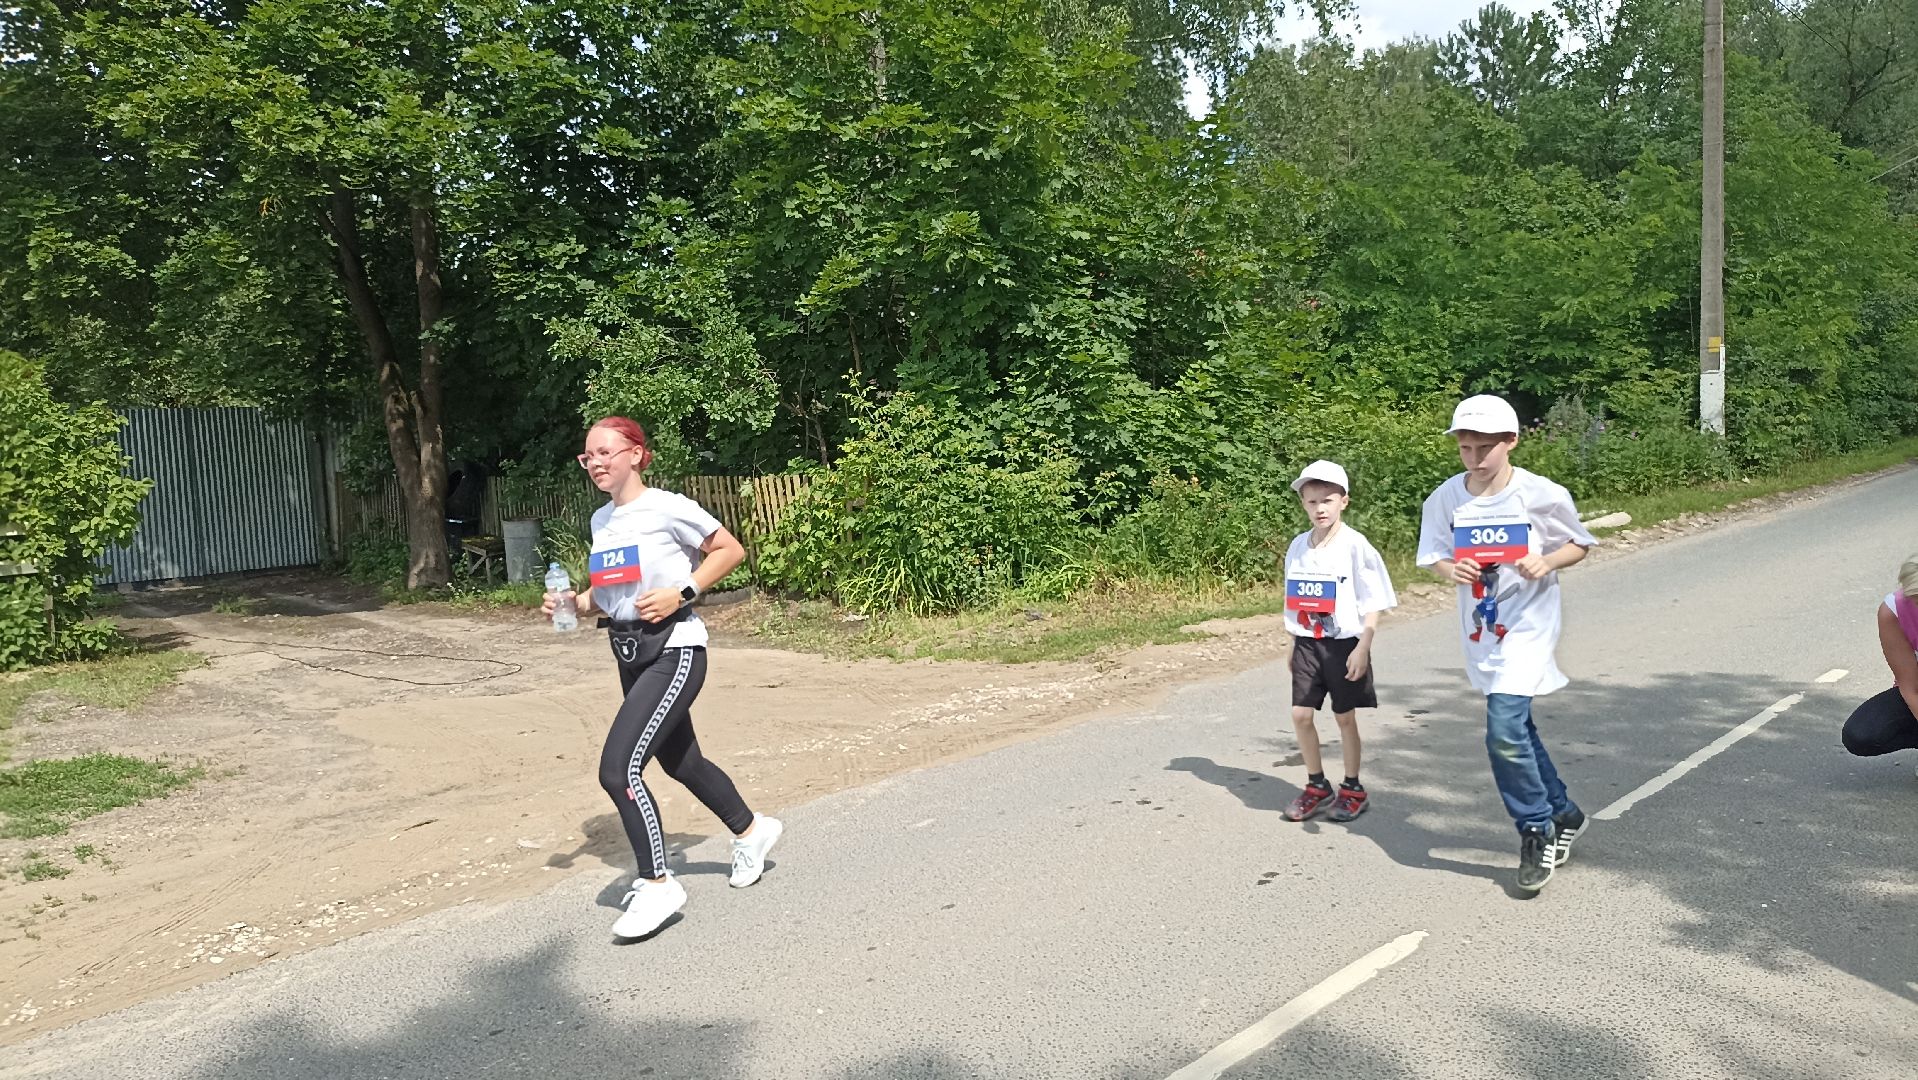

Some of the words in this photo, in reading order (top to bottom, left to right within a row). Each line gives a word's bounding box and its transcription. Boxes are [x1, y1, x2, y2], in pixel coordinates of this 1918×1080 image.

[1470, 528, 1509, 545] 306
[603, 550, 626, 568] 124
[1297, 582, 1323, 597] 308
